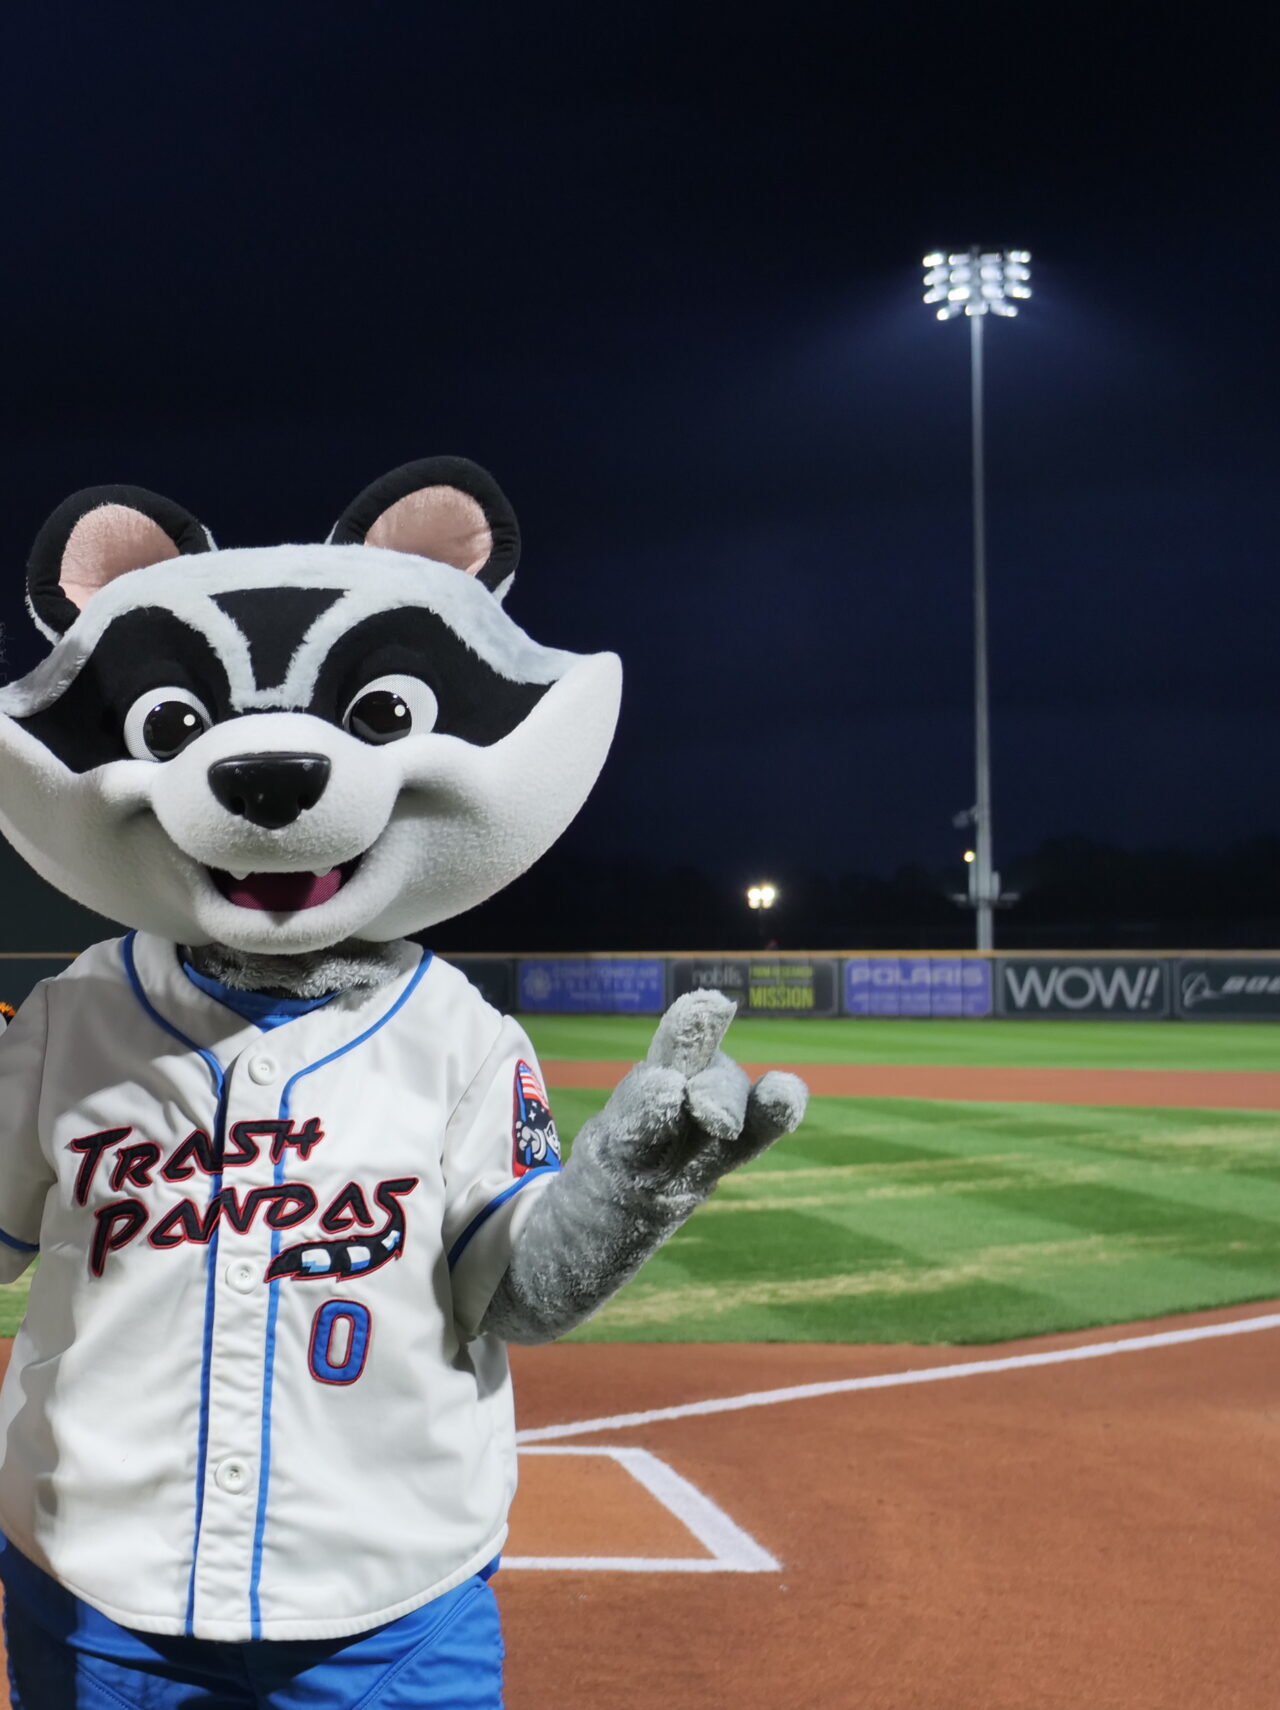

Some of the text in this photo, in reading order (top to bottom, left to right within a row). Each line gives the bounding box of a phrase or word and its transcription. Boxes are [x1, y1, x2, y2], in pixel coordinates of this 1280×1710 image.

[750, 985, 815, 1009] MISSION
[851, 966, 983, 987] POLARIS
[1005, 967, 1160, 1009] WOW!
[70, 1117, 325, 1207] TRASH
[91, 1176, 419, 1283] PANDAS
[308, 1299, 372, 1385] 0
